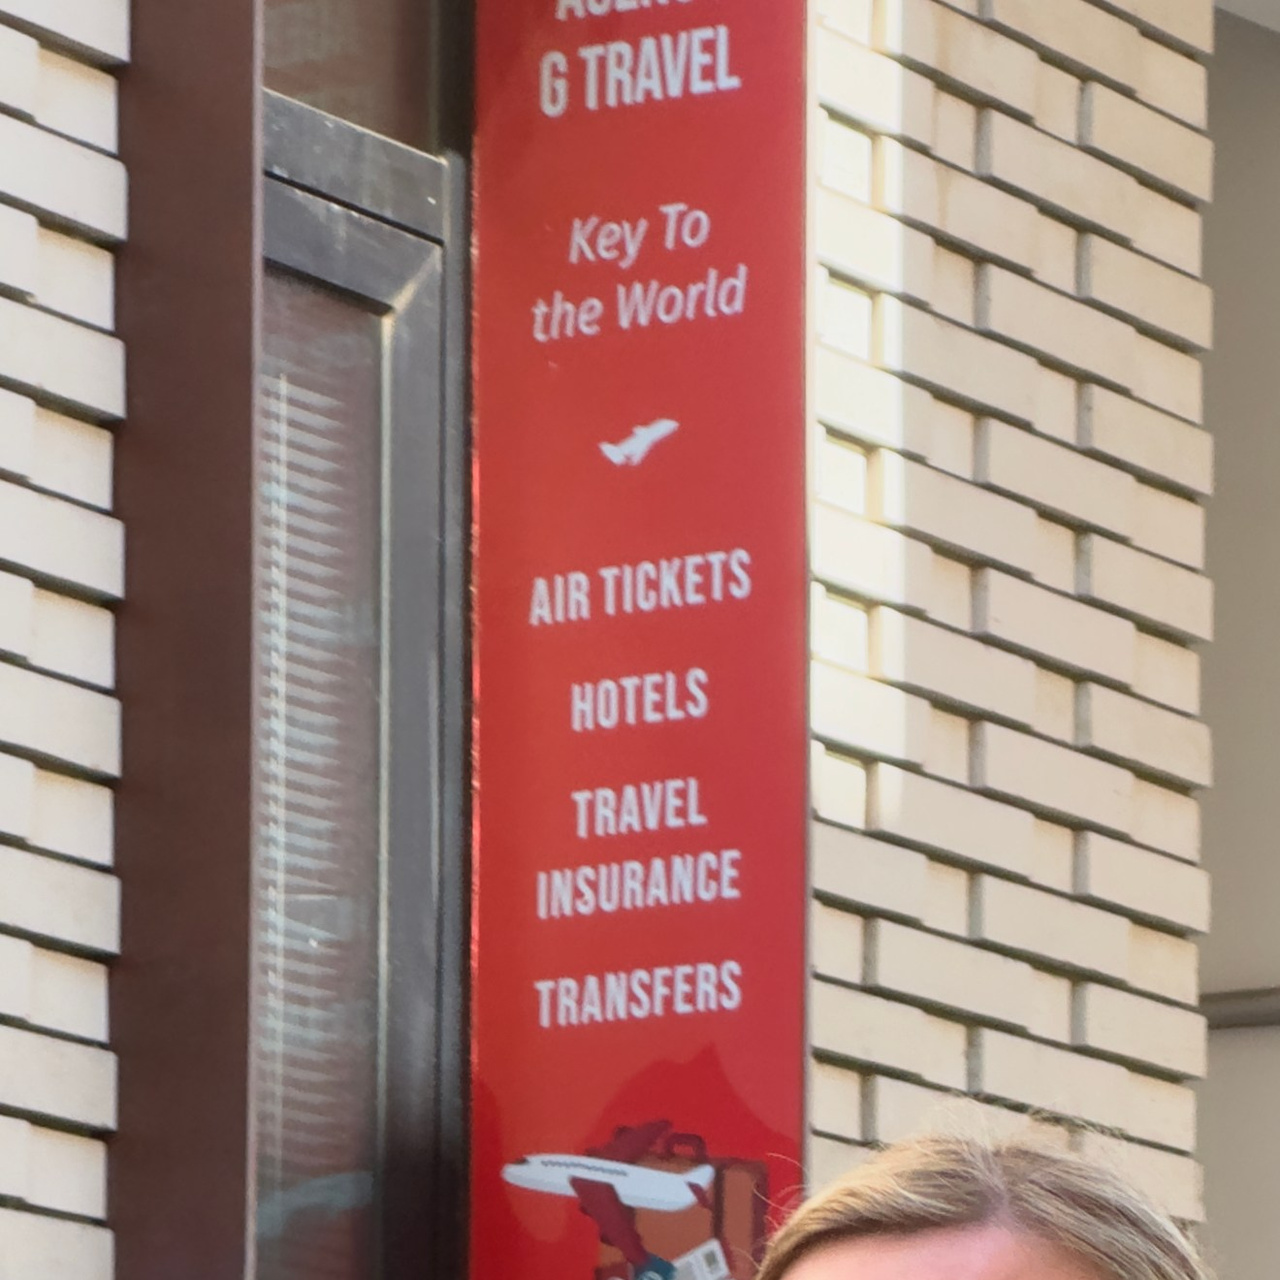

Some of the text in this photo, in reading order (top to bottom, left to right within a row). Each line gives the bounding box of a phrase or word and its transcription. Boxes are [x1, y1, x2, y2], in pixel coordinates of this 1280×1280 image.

[541, 25, 741, 117] G TRAVEL
[570, 203, 709, 268] Key To
[532, 264, 747, 342] the World
[530, 549, 750, 625] AIR TICKETS
[572, 668, 707, 731] HOTELS
[571, 778, 707, 838] TRAVEL
[538, 850, 740, 919] INSURANCE
[535, 961, 741, 1027] TRANSFERS
